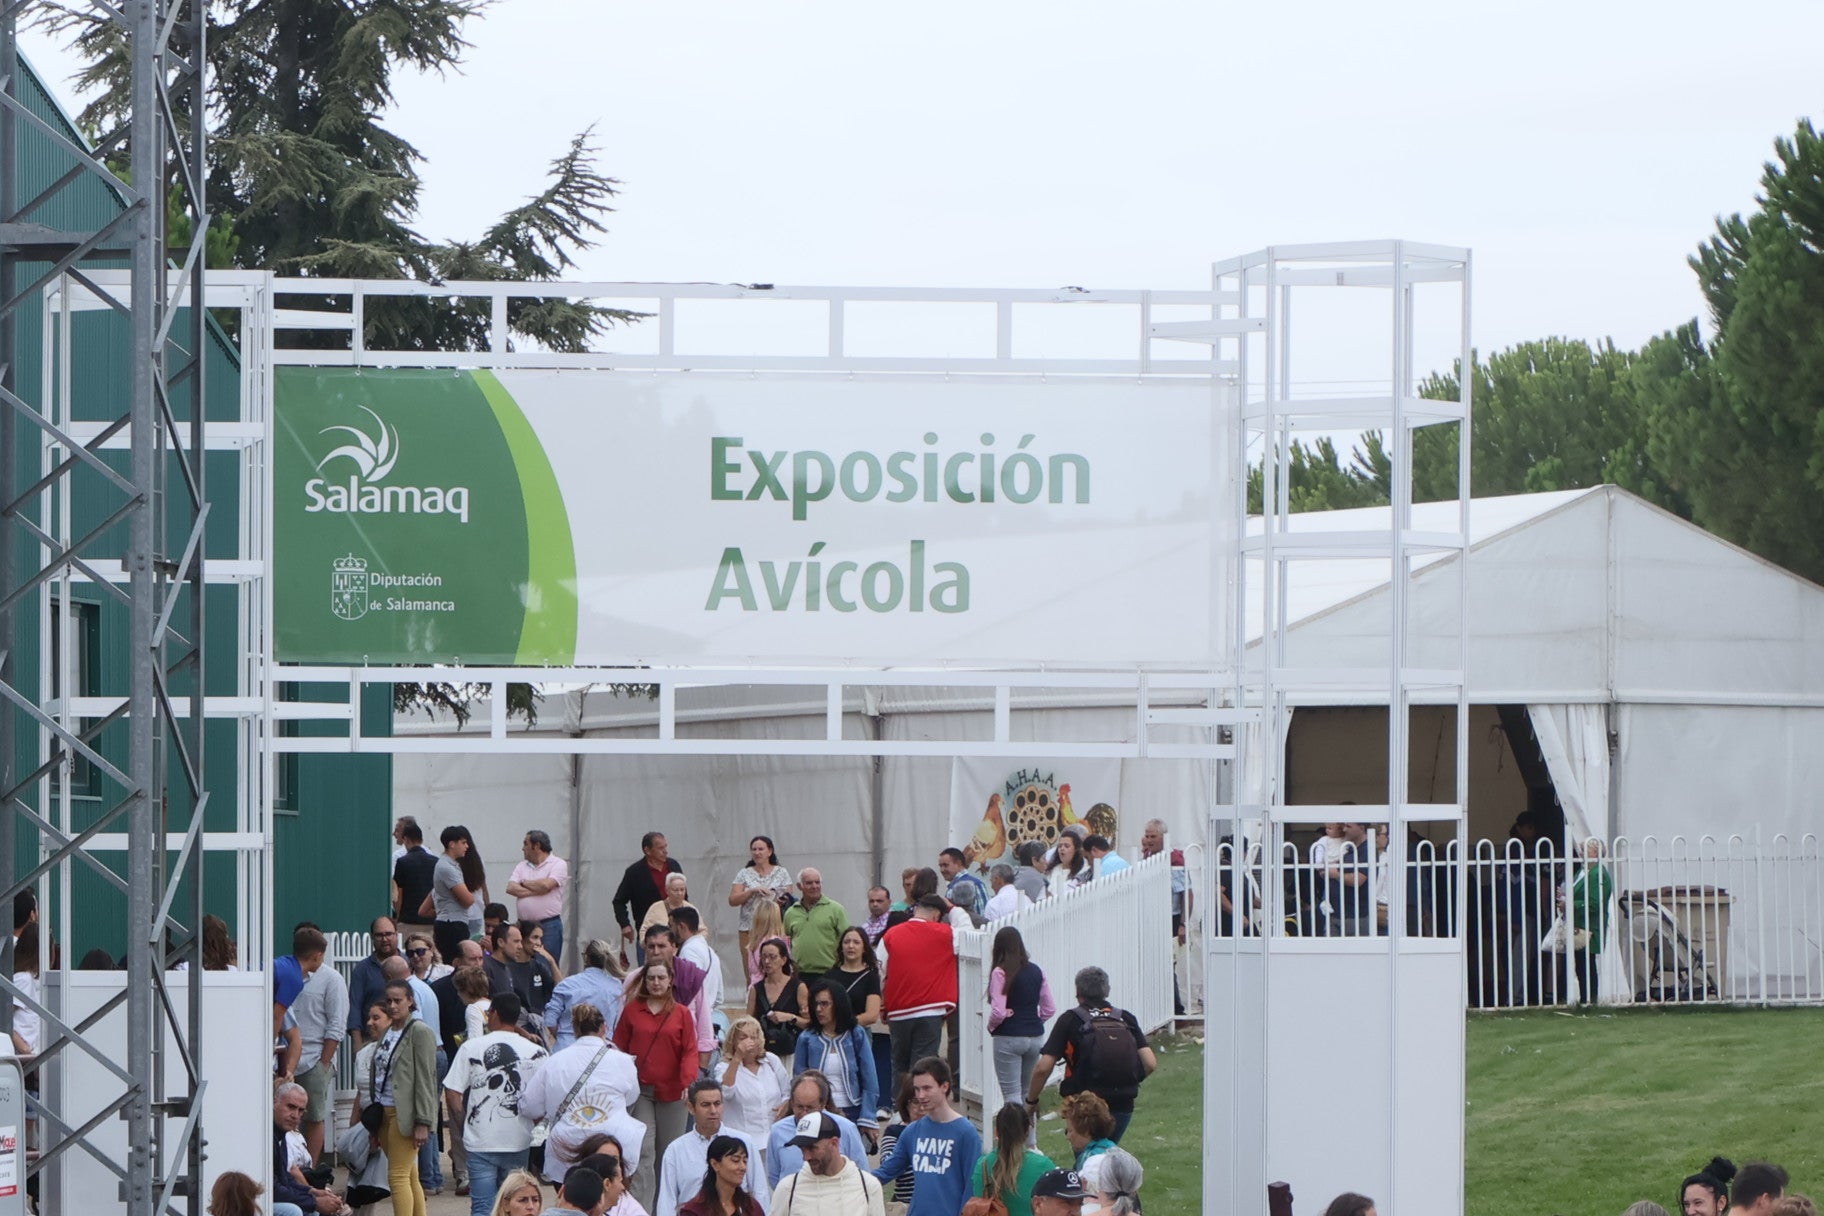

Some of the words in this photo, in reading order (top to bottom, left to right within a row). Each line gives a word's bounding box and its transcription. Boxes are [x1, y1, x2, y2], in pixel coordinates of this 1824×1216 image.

[709, 431, 1092, 521] Exposición
[304, 475, 469, 523] Salamaq
[370, 572, 442, 588] Diputación
[703, 539, 971, 615] Avícola
[370, 599, 382, 611] de
[386, 597, 455, 612] Salamanca
[916, 1137, 955, 1157] WAVE
